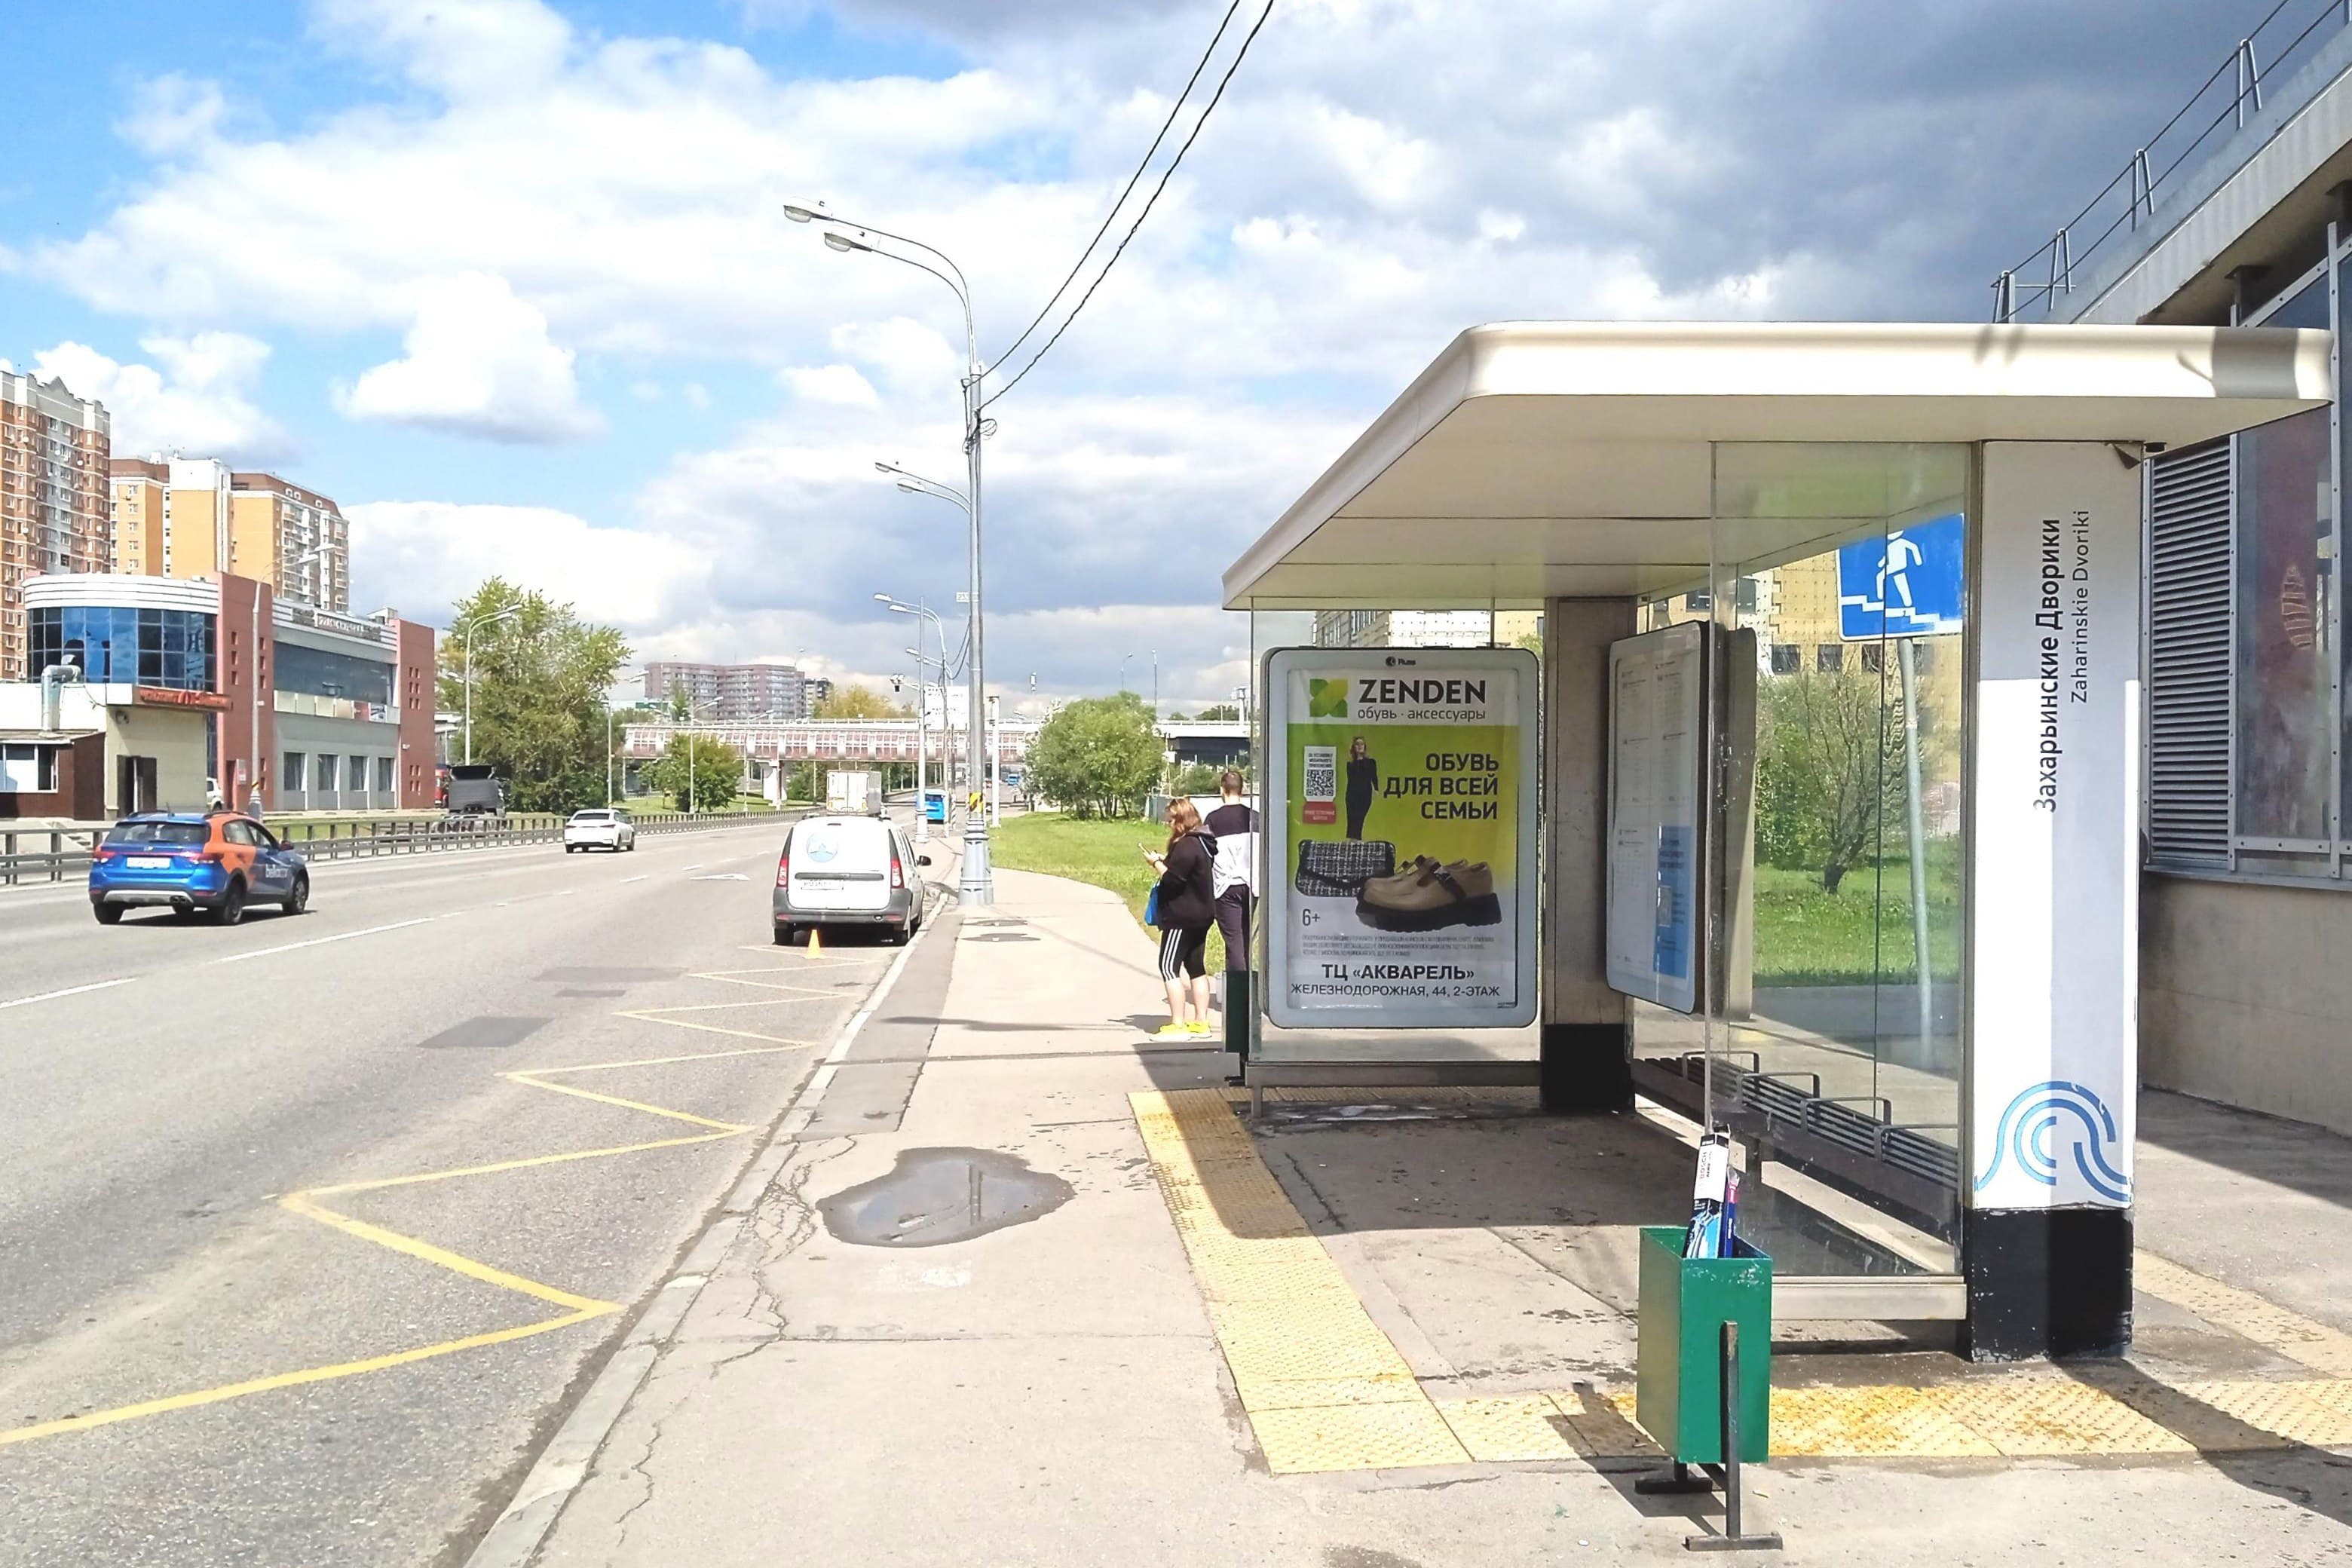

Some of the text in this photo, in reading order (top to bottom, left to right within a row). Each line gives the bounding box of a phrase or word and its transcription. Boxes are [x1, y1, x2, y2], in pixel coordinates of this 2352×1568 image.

[2071, 511, 2089, 703] Zaharinskie Dvoriki
[2033, 520, 2065, 813] Захарьинские Дворики
[1358, 679, 1486, 704] ZENDEN
[1358, 706, 1486, 722] обувь аксессуары
[1426, 753, 1499, 771] ОБУВЬ
[1383, 773, 1498, 798] ДЛЯ ВСЕЙ
[1421, 801, 1498, 819] СЕМЬИ
[1302, 908, 1321, 926] 6+
[1321, 964, 1475, 981] ТЦ «АКВАРЕЛЬ»
[1291, 983, 1500, 997] ЖЕЛЕЗНОДОРОЖНАЯ, 44, 2-ЭТАЖ
